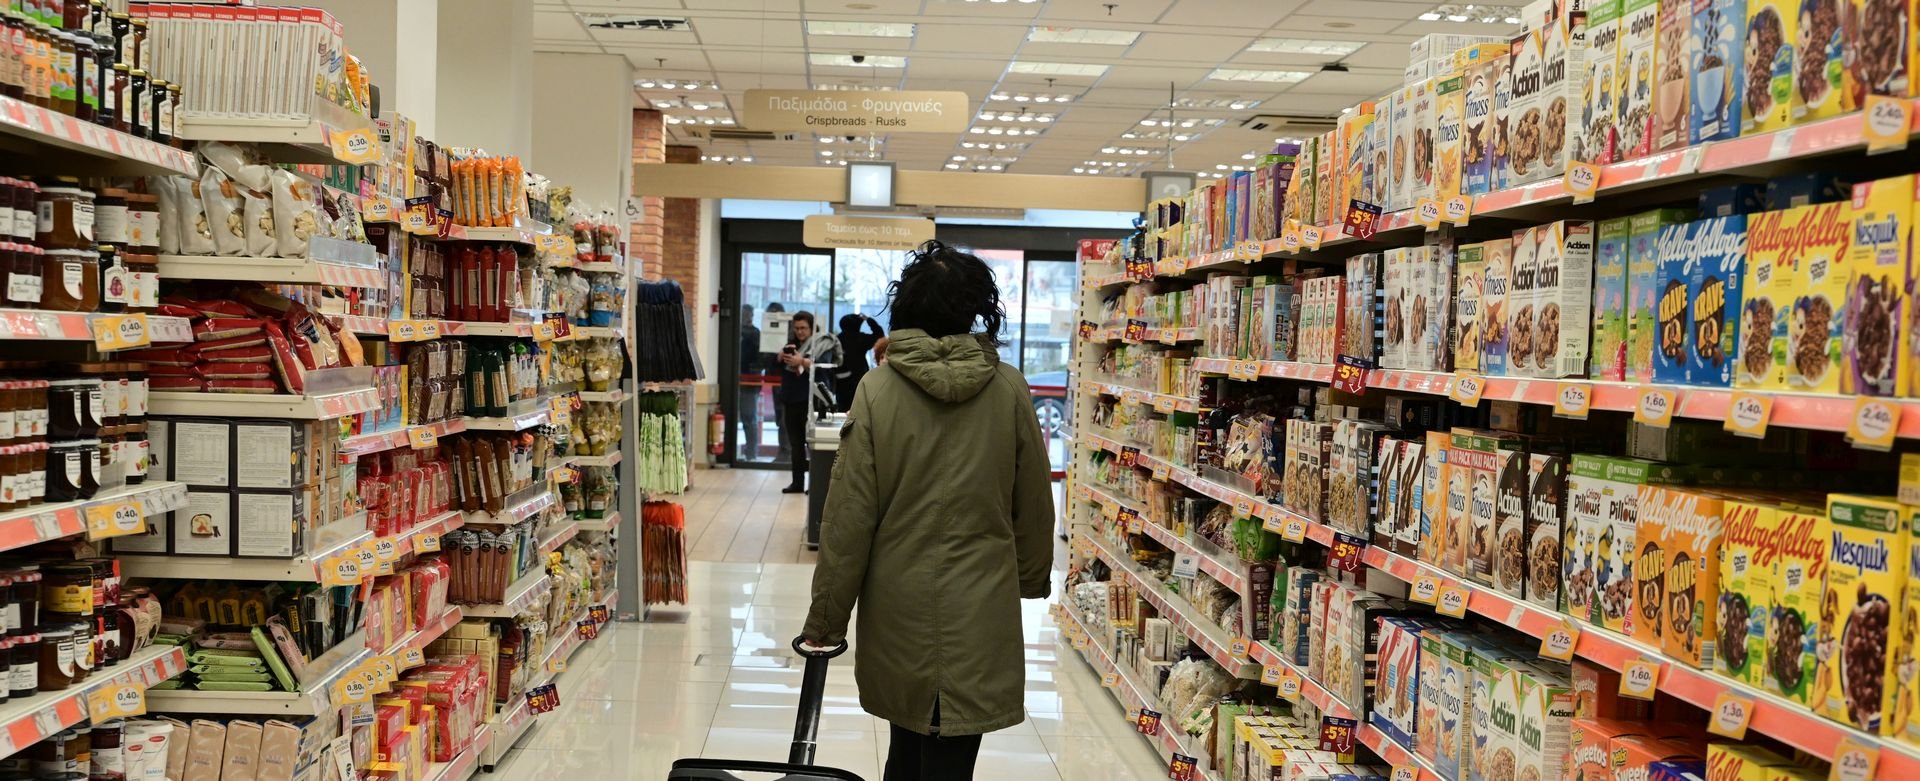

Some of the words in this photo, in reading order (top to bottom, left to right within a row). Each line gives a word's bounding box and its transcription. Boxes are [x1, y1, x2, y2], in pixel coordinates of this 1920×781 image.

[1594, 26, 1617, 49] alpha
[1631, 11, 1655, 38] alpha
[1511, 68, 1540, 101] Action
[1542, 56, 1565, 88] Action
[769, 96, 848, 114] Παξιμάδια
[863, 97, 943, 116] Φρυγανιές
[1465, 90, 1490, 120] Fitness
[1494, 81, 1510, 111] Fitne
[805, 115, 866, 128] Crispbreads
[875, 116, 907, 127] Rusks
[1438, 115, 1459, 144] Fitness
[1350, 209, 1372, 225] -5%
[1566, 241, 1591, 250] Action
[1483, 265, 1507, 297] Fitness
[1535, 258, 1559, 288] Action
[1458, 290, 1477, 316] Fitness
[1659, 283, 1688, 322] KRAVE
[1693, 280, 1725, 322] KRAVE
[1337, 364, 1360, 379] -5%
[1459, 451, 1471, 466] PACK
[1471, 450, 1482, 467] MAXI
[1482, 454, 1496, 471] PACK
[1627, 466, 1644, 477] VALLEY
[1471, 487, 1492, 520] Fitness
[1497, 488, 1523, 518] Action
[1530, 494, 1557, 526] Action
[1574, 493, 1600, 517] Pillows
[1609, 500, 1638, 524] Pillow
[1334, 543, 1357, 558] -5%
[1638, 549, 1665, 581] KRAVE
[1831, 530, 1889, 577] Nesquik
[1668, 560, 1697, 594] KRAVE
[1420, 670, 1440, 705] Fitness
[1439, 677, 1461, 715] Fitness
[1574, 678, 1597, 696] Sweetos
[1490, 698, 1516, 735] Action
[1324, 726, 1347, 740] -5%
[1520, 712, 1541, 752] Action
[1173, 760, 1189, 772] -5%
[1573, 744, 1607, 768] Sweetos
